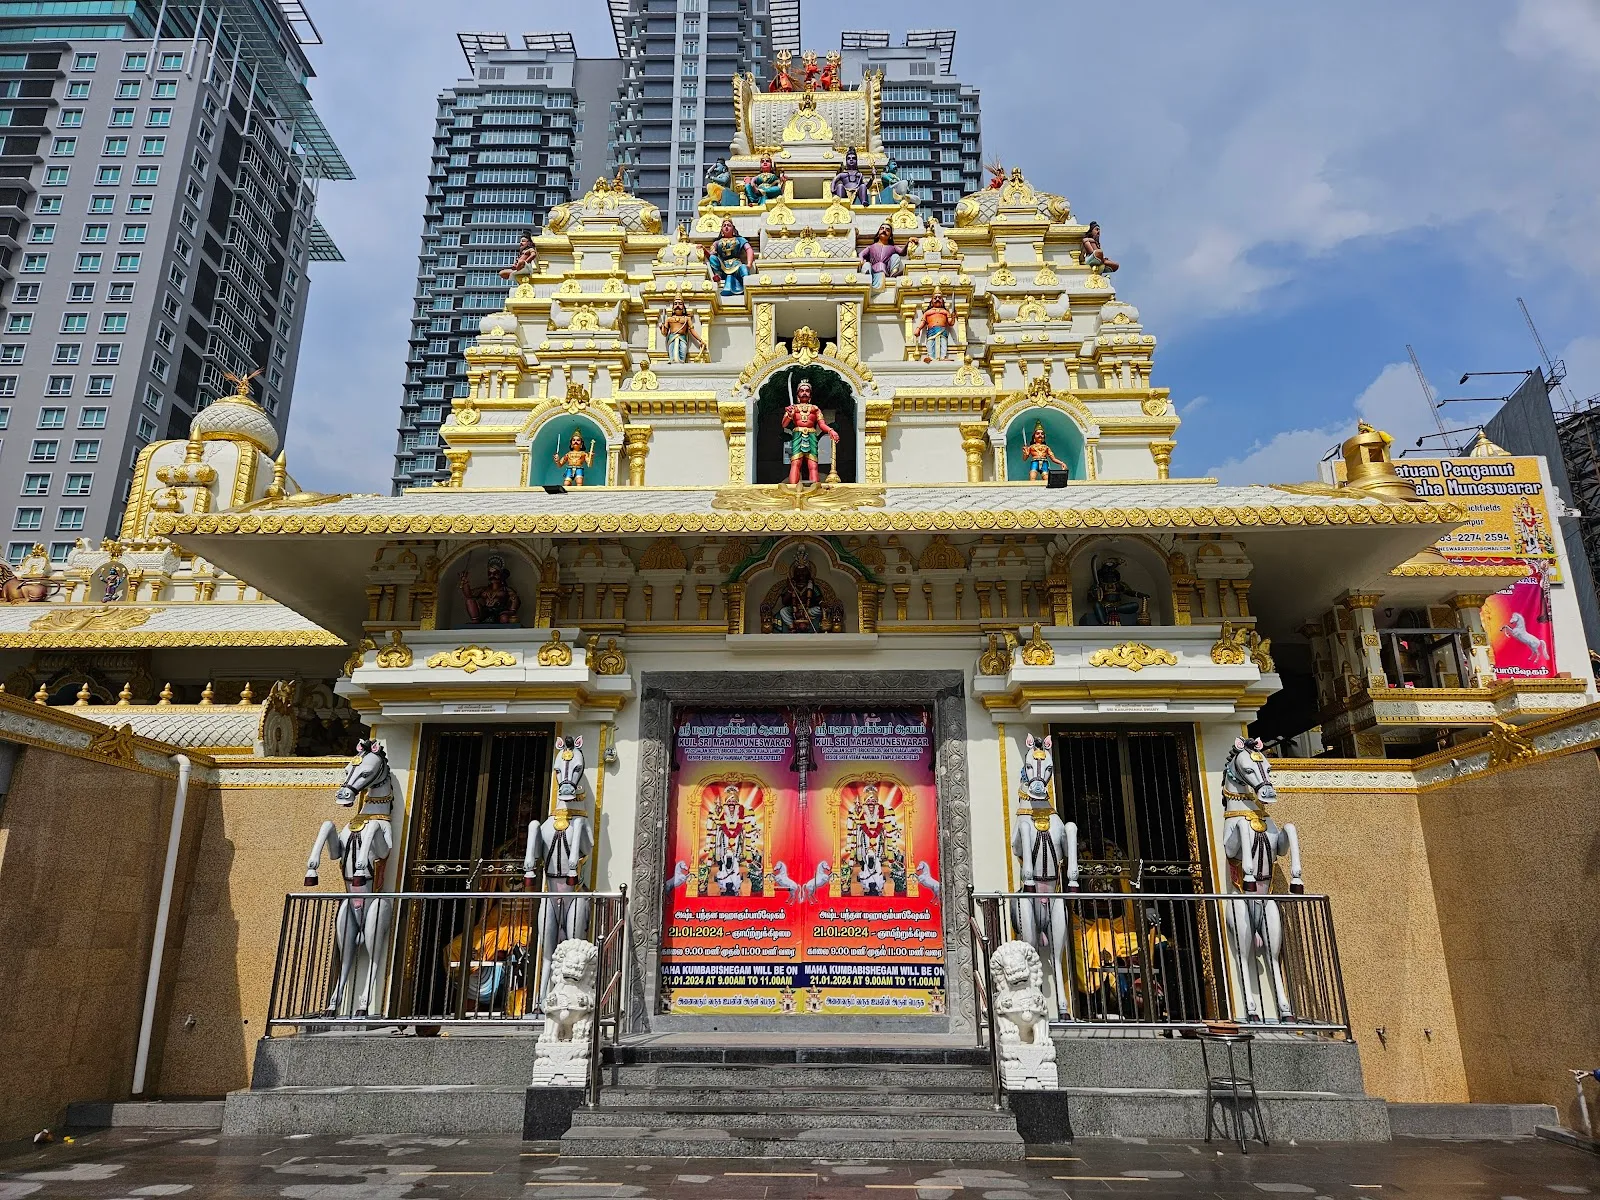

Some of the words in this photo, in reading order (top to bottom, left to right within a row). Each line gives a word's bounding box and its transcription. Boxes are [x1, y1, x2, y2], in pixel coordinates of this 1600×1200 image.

[1395, 464, 1438, 477] atuan
[1441, 461, 1514, 480] Penganut
[1414, 480, 1443, 496] aha
[1446, 480, 1542, 496] Muneswarar
[1468, 504, 1501, 512] ickfields
[1485, 533, 1509, 542] 2594
[678, 738, 697, 747] KUIL
[699, 738, 712, 747] SRI
[713, 738, 736, 747] MAHA
[737, 738, 791, 747] MUNESWARAR
[815, 737, 834, 746] KUIL
[835, 737, 849, 746] SRI
[850, 737, 873, 746] MAHA
[874, 737, 929, 746] MUNESWARAR
[668, 926, 723, 937] 21.01.2024
[813, 926, 868, 937] 21.01.2024
[684, 947, 703, 956] 9.00
[741, 947, 760, 956] 11.00
[831, 947, 849, 956] 9.00
[888, 947, 907, 956] 11.00
[682, 966, 751, 975] KUMBABISHEGAM
[753, 966, 772, 975] WILL
[774, 966, 785, 975] BE
[786, 966, 798, 975] ON
[805, 965, 827, 974] MAHA
[829, 965, 898, 975] KUMBABISHEGAM
[900, 966, 919, 975] WILL
[921, 966, 932, 976] BE
[663, 976, 704, 985] 21.01.2024
[705, 976, 715, 985] AT
[717, 976, 746, 985] 9.00AM
[747, 976, 758, 985] TO
[760, 976, 792, 985] 11.00AM
[810, 976, 851, 985] 21.01.2024
[853, 976, 862, 985] AT
[865, 976, 893, 985] 9.00AM
[895, 976, 906, 986] TO
[908, 977, 940, 986] 11.00AM
